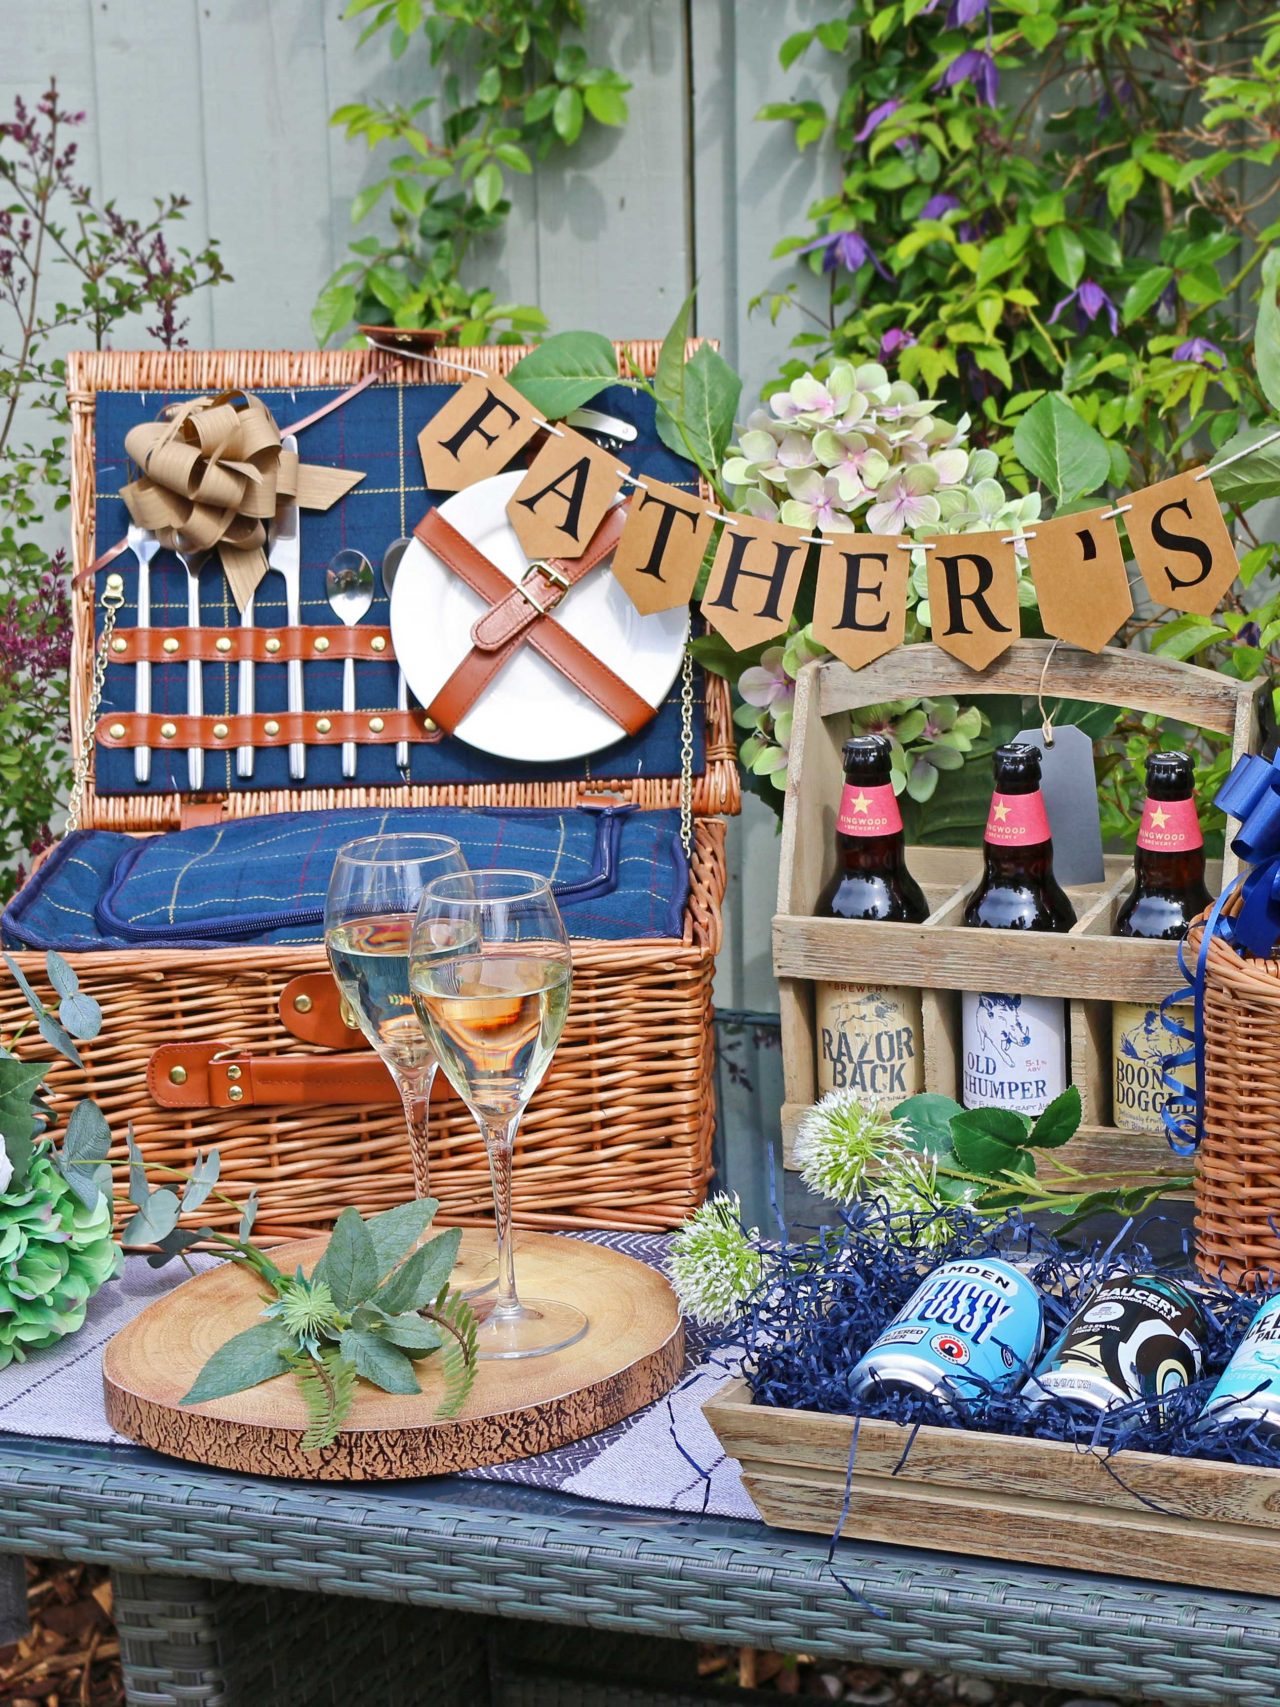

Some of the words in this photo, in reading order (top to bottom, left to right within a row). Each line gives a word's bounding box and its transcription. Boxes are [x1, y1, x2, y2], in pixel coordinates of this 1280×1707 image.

[438, 388, 1214, 637] FATHER'S
[986, 822, 1026, 834] NGWOOD
[834, 984, 890, 993] BREWERY
[822, 1027, 915, 1064] RAZOR
[833, 1059, 907, 1094] BACK
[967, 1052, 997, 1075] OLD
[1116, 1057, 1164, 1091] BOON
[964, 1070, 1047, 1100] THUMPER
[925, 1266, 1010, 1289] AMDEN
[890, 1279, 1014, 1344] FUSSY
[1097, 1287, 1182, 1318] SAUCERY
[1142, 1300, 1159, 1313] PALE
[1158, 1310, 1173, 1321] ALE
[1243, 1313, 1274, 1341] CE
